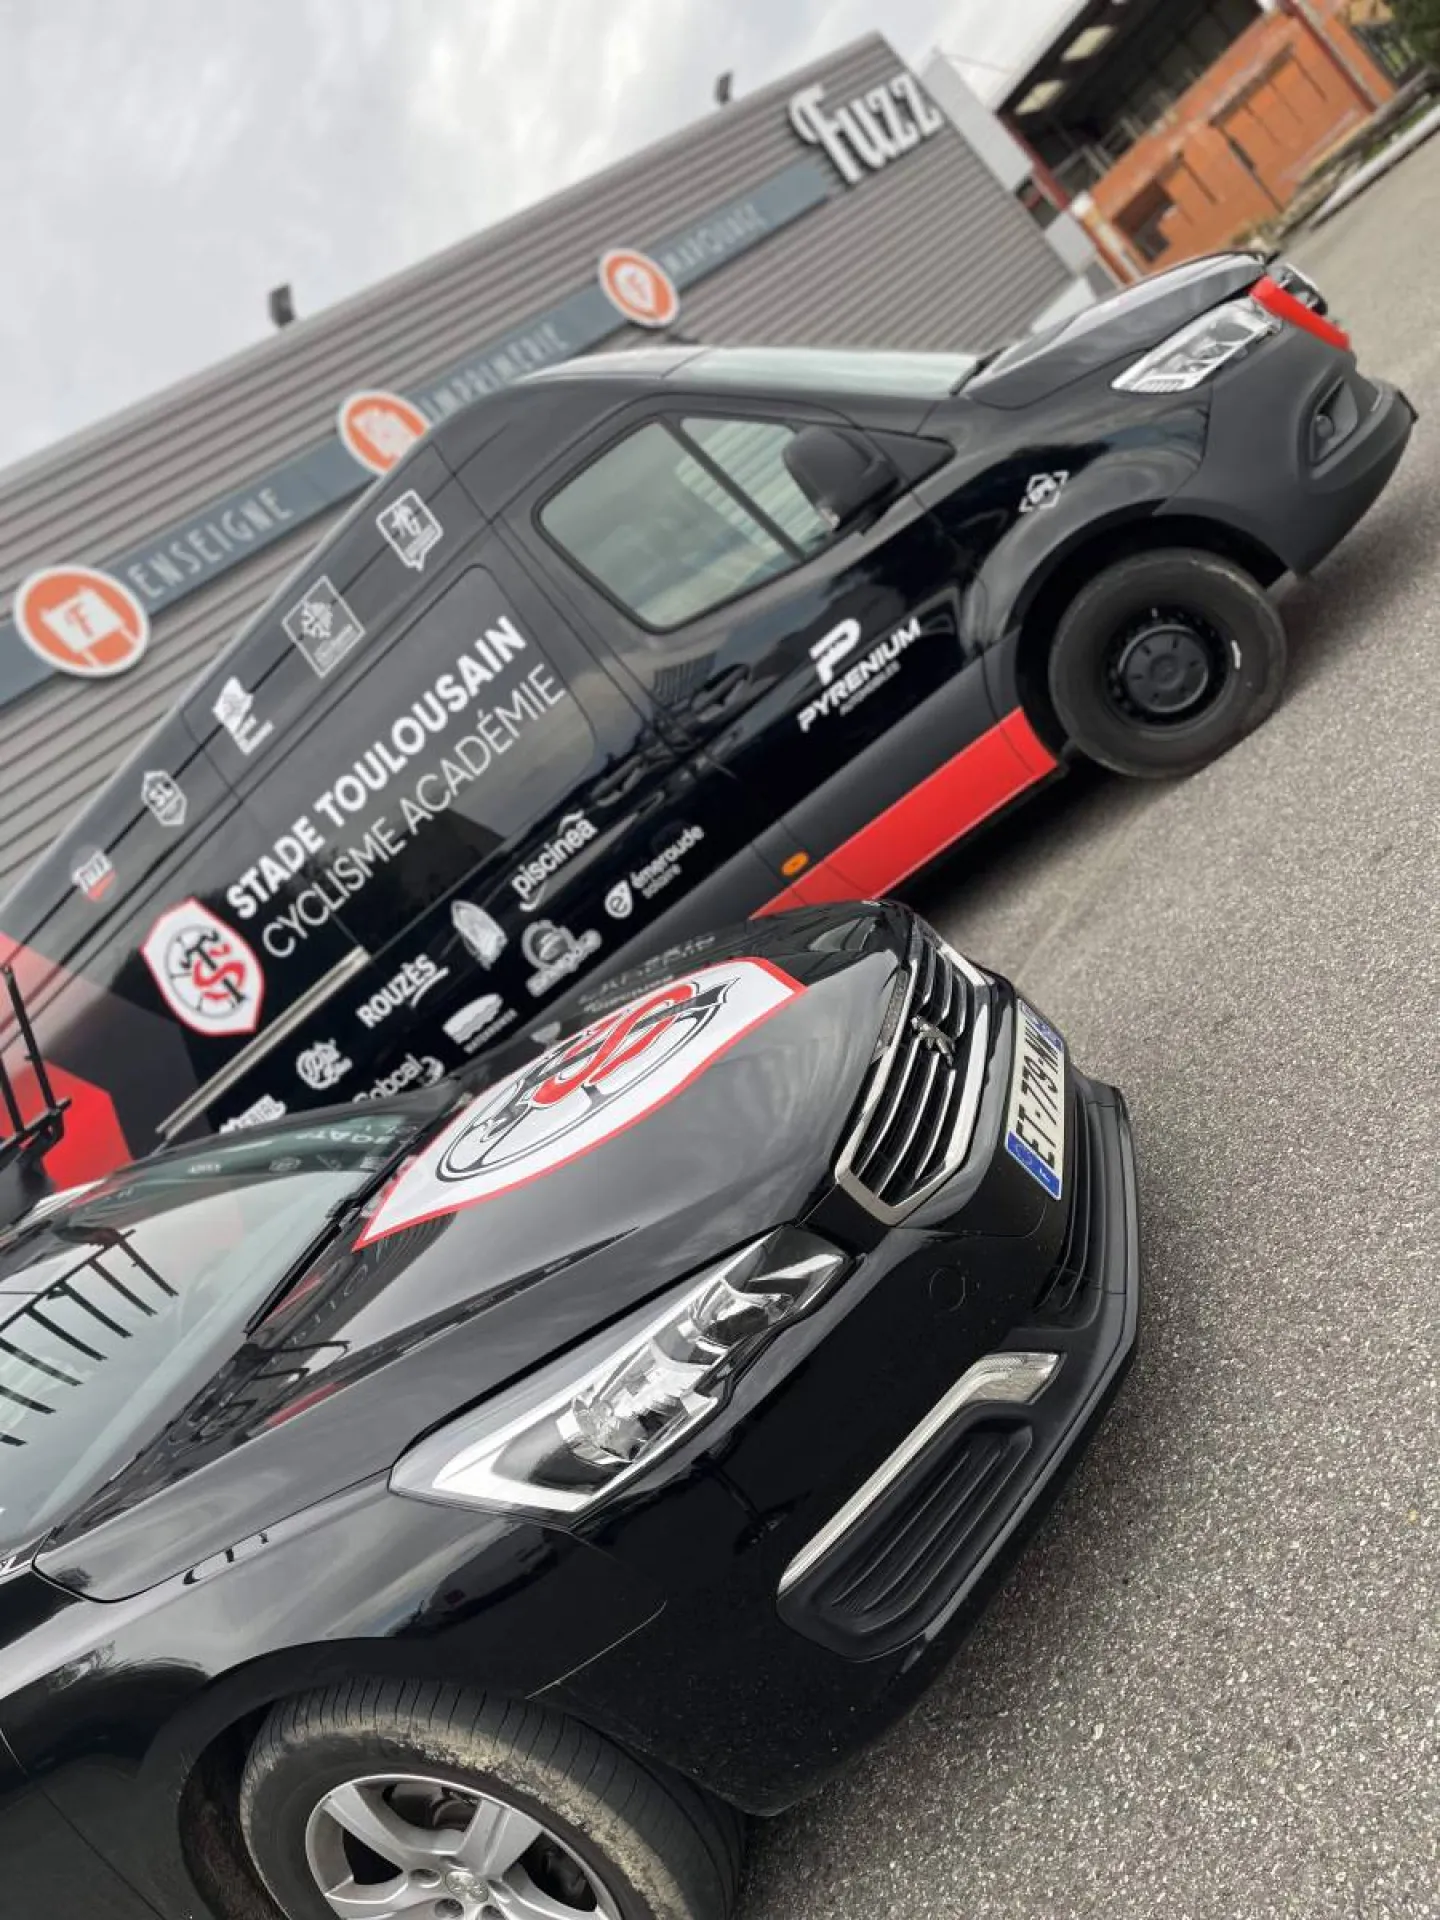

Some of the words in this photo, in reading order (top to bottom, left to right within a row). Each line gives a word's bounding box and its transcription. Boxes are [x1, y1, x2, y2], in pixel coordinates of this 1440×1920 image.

[127, 487, 294, 599] ENSEIGNE
[796, 615, 922, 732] PYRENIUM
[226, 815, 326, 920] STADE
[313, 615, 527, 828] TOULOUSAIN
[262, 816, 407, 958] CYCLISME
[399, 662, 567, 836] ACADÉMIE
[355, 953, 438, 1029] ROUZÈS
